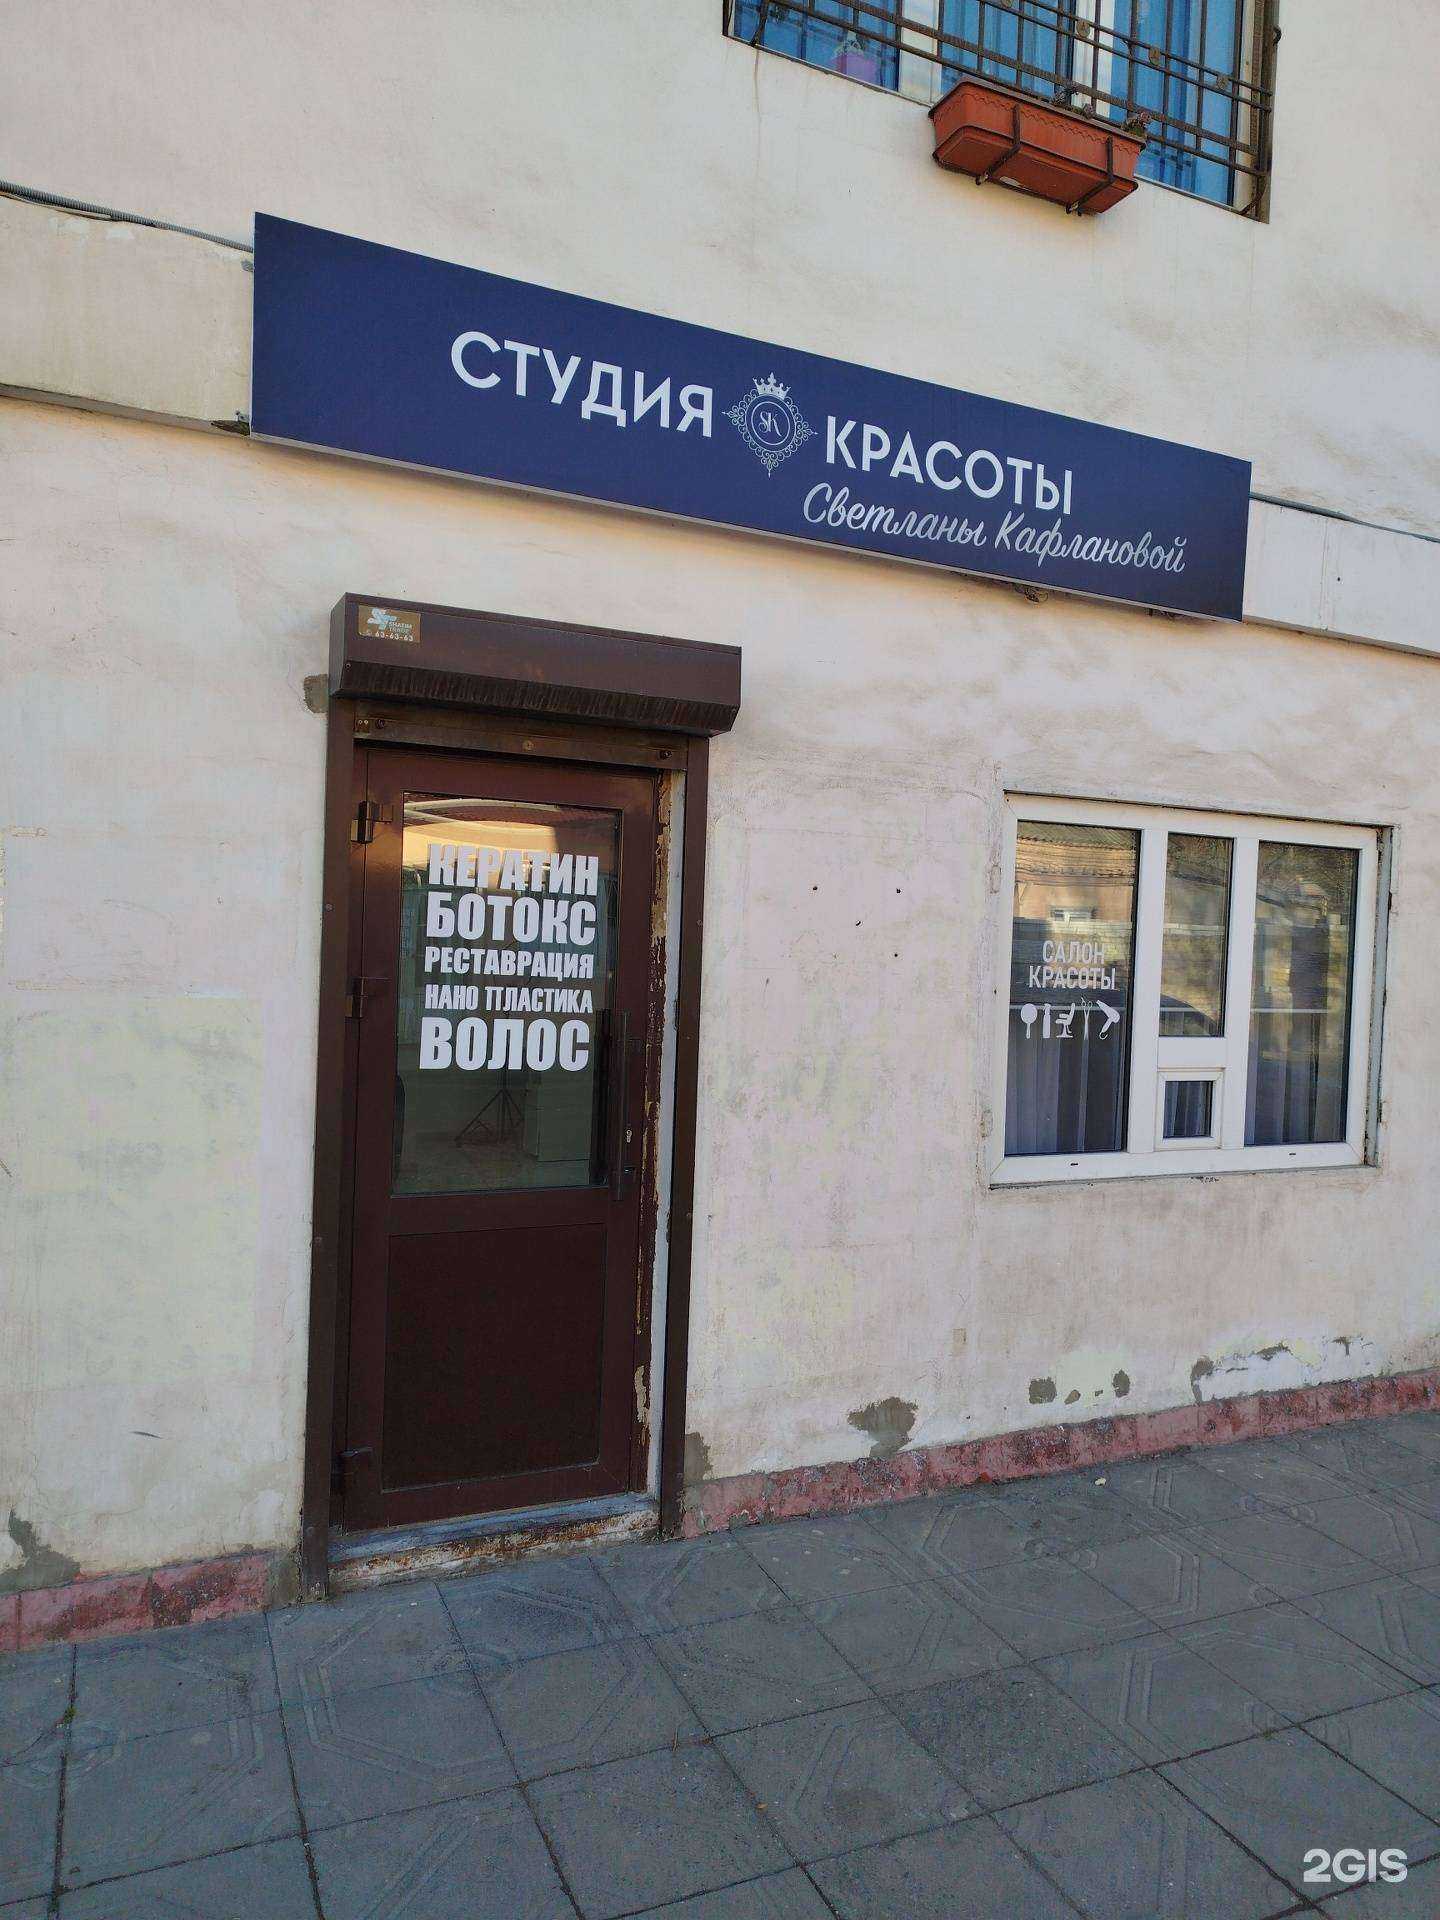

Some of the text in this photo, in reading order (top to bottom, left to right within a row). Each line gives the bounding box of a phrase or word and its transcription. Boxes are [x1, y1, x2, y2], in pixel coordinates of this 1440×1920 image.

[451, 331, 1073, 515] СТУДИЯ КРАСОТЫ
[803, 482, 1188, 573] Светланы Кафлановой
[428, 843, 599, 896] КЕРАТИН
[426, 891, 597, 946] БОТОКС
[424, 946, 594, 982] РЕСТАВРАЦИЯ
[1028, 965, 1116, 990] КРАСОТЫ
[1042, 940, 1105, 965] САЛОН
[425, 984, 593, 1013] НАНО ПЛАСТИКА
[419, 1016, 590, 1072] ВОЛОС
